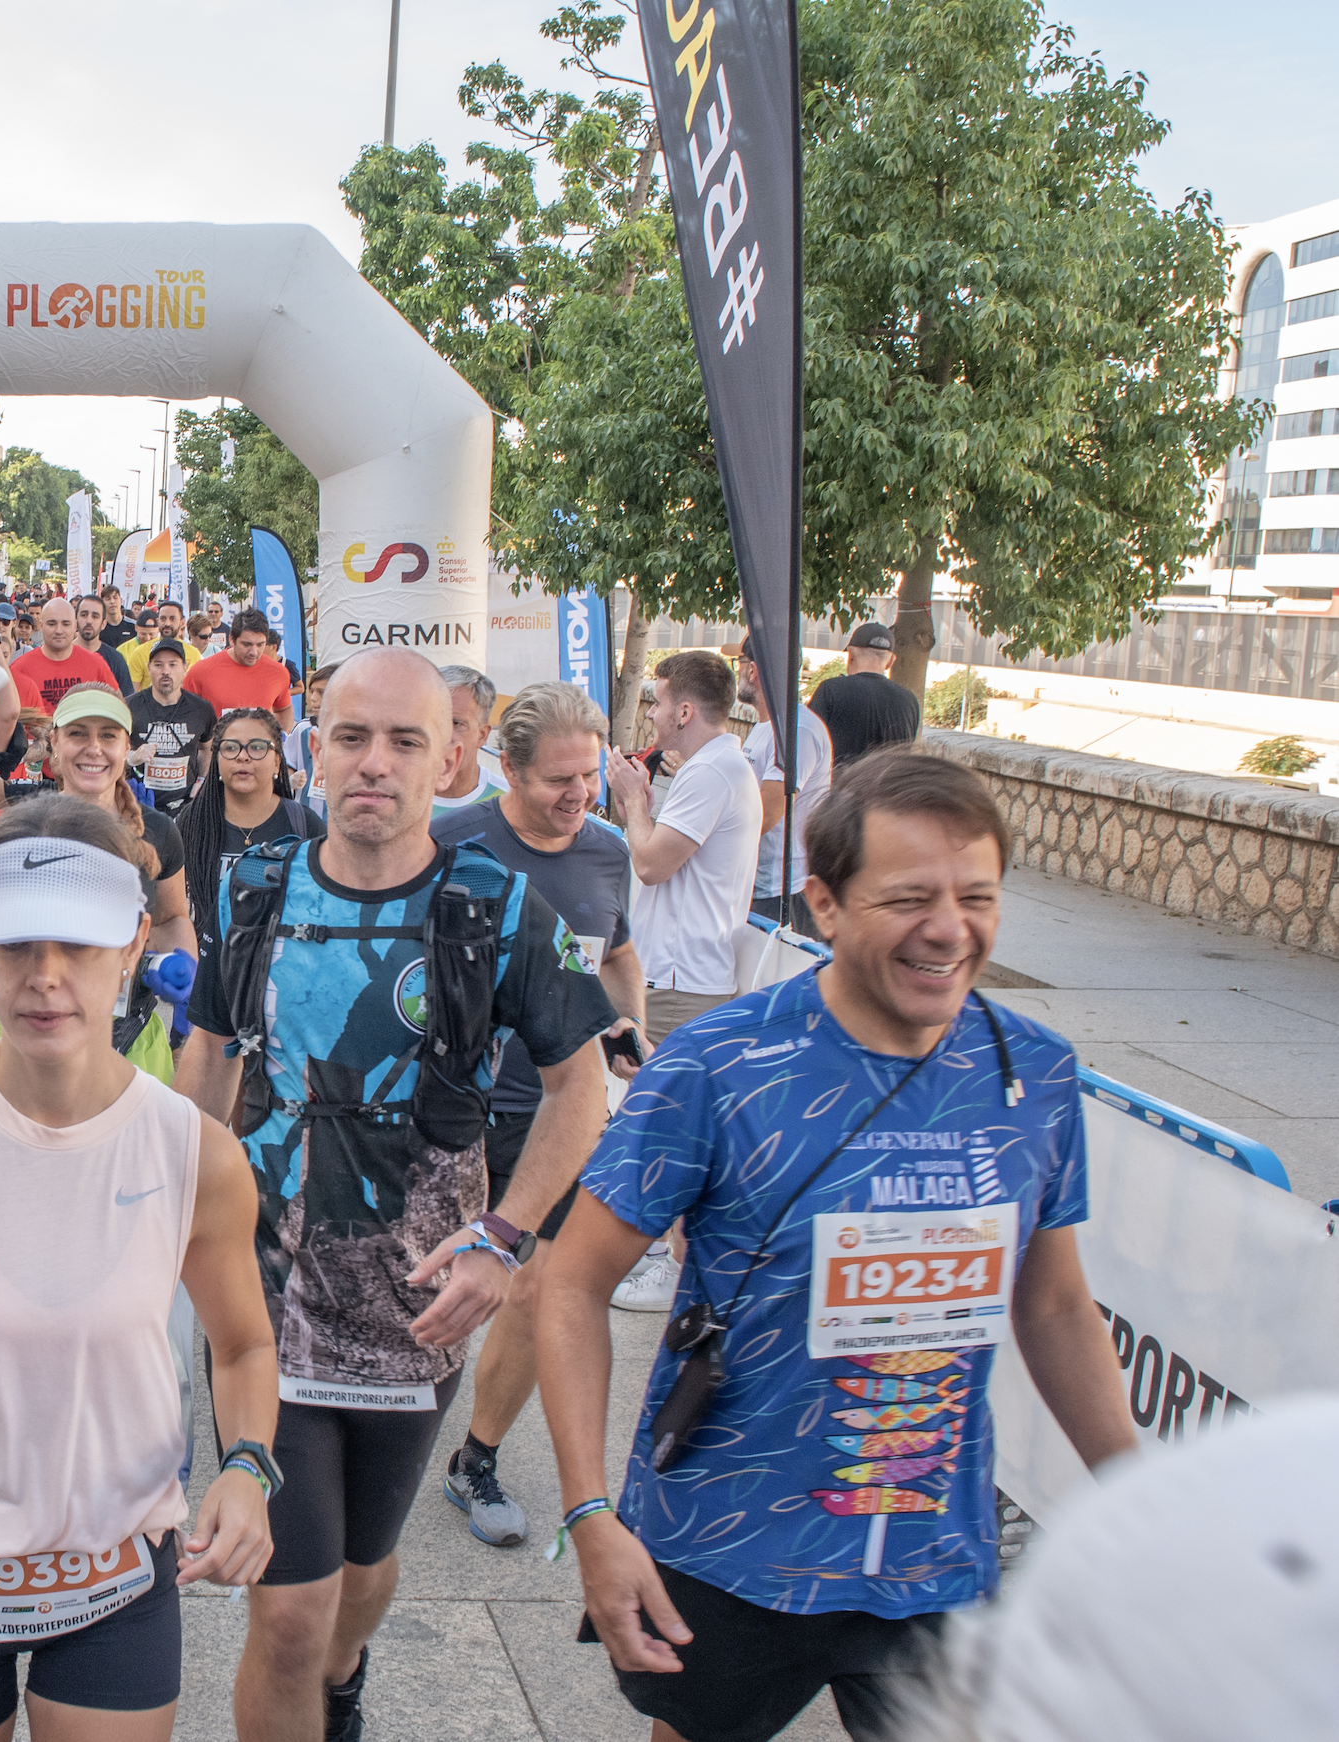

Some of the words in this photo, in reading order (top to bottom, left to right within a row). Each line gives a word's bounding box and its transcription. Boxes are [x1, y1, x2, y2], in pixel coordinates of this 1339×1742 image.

[155, 269, 206, 284] TOUR
[6, 282, 207, 330] PLOGGING
[438, 557, 467, 566] Consejo
[438, 566, 469, 575] Superior
[438, 575, 448, 583] de
[449, 576, 477, 584] Deportes
[490, 616, 552, 630] PLOGGING
[341, 622, 472, 646] GARMIN
[149, 767, 184, 778] 18086
[864, 1131, 964, 1150] GENERALI
[870, 1169, 977, 1206] MÁLAGA
[840, 1255, 990, 1300] 19234
[295, 1388, 418, 1405] #HAZDEPORTEPORELPLANETA
